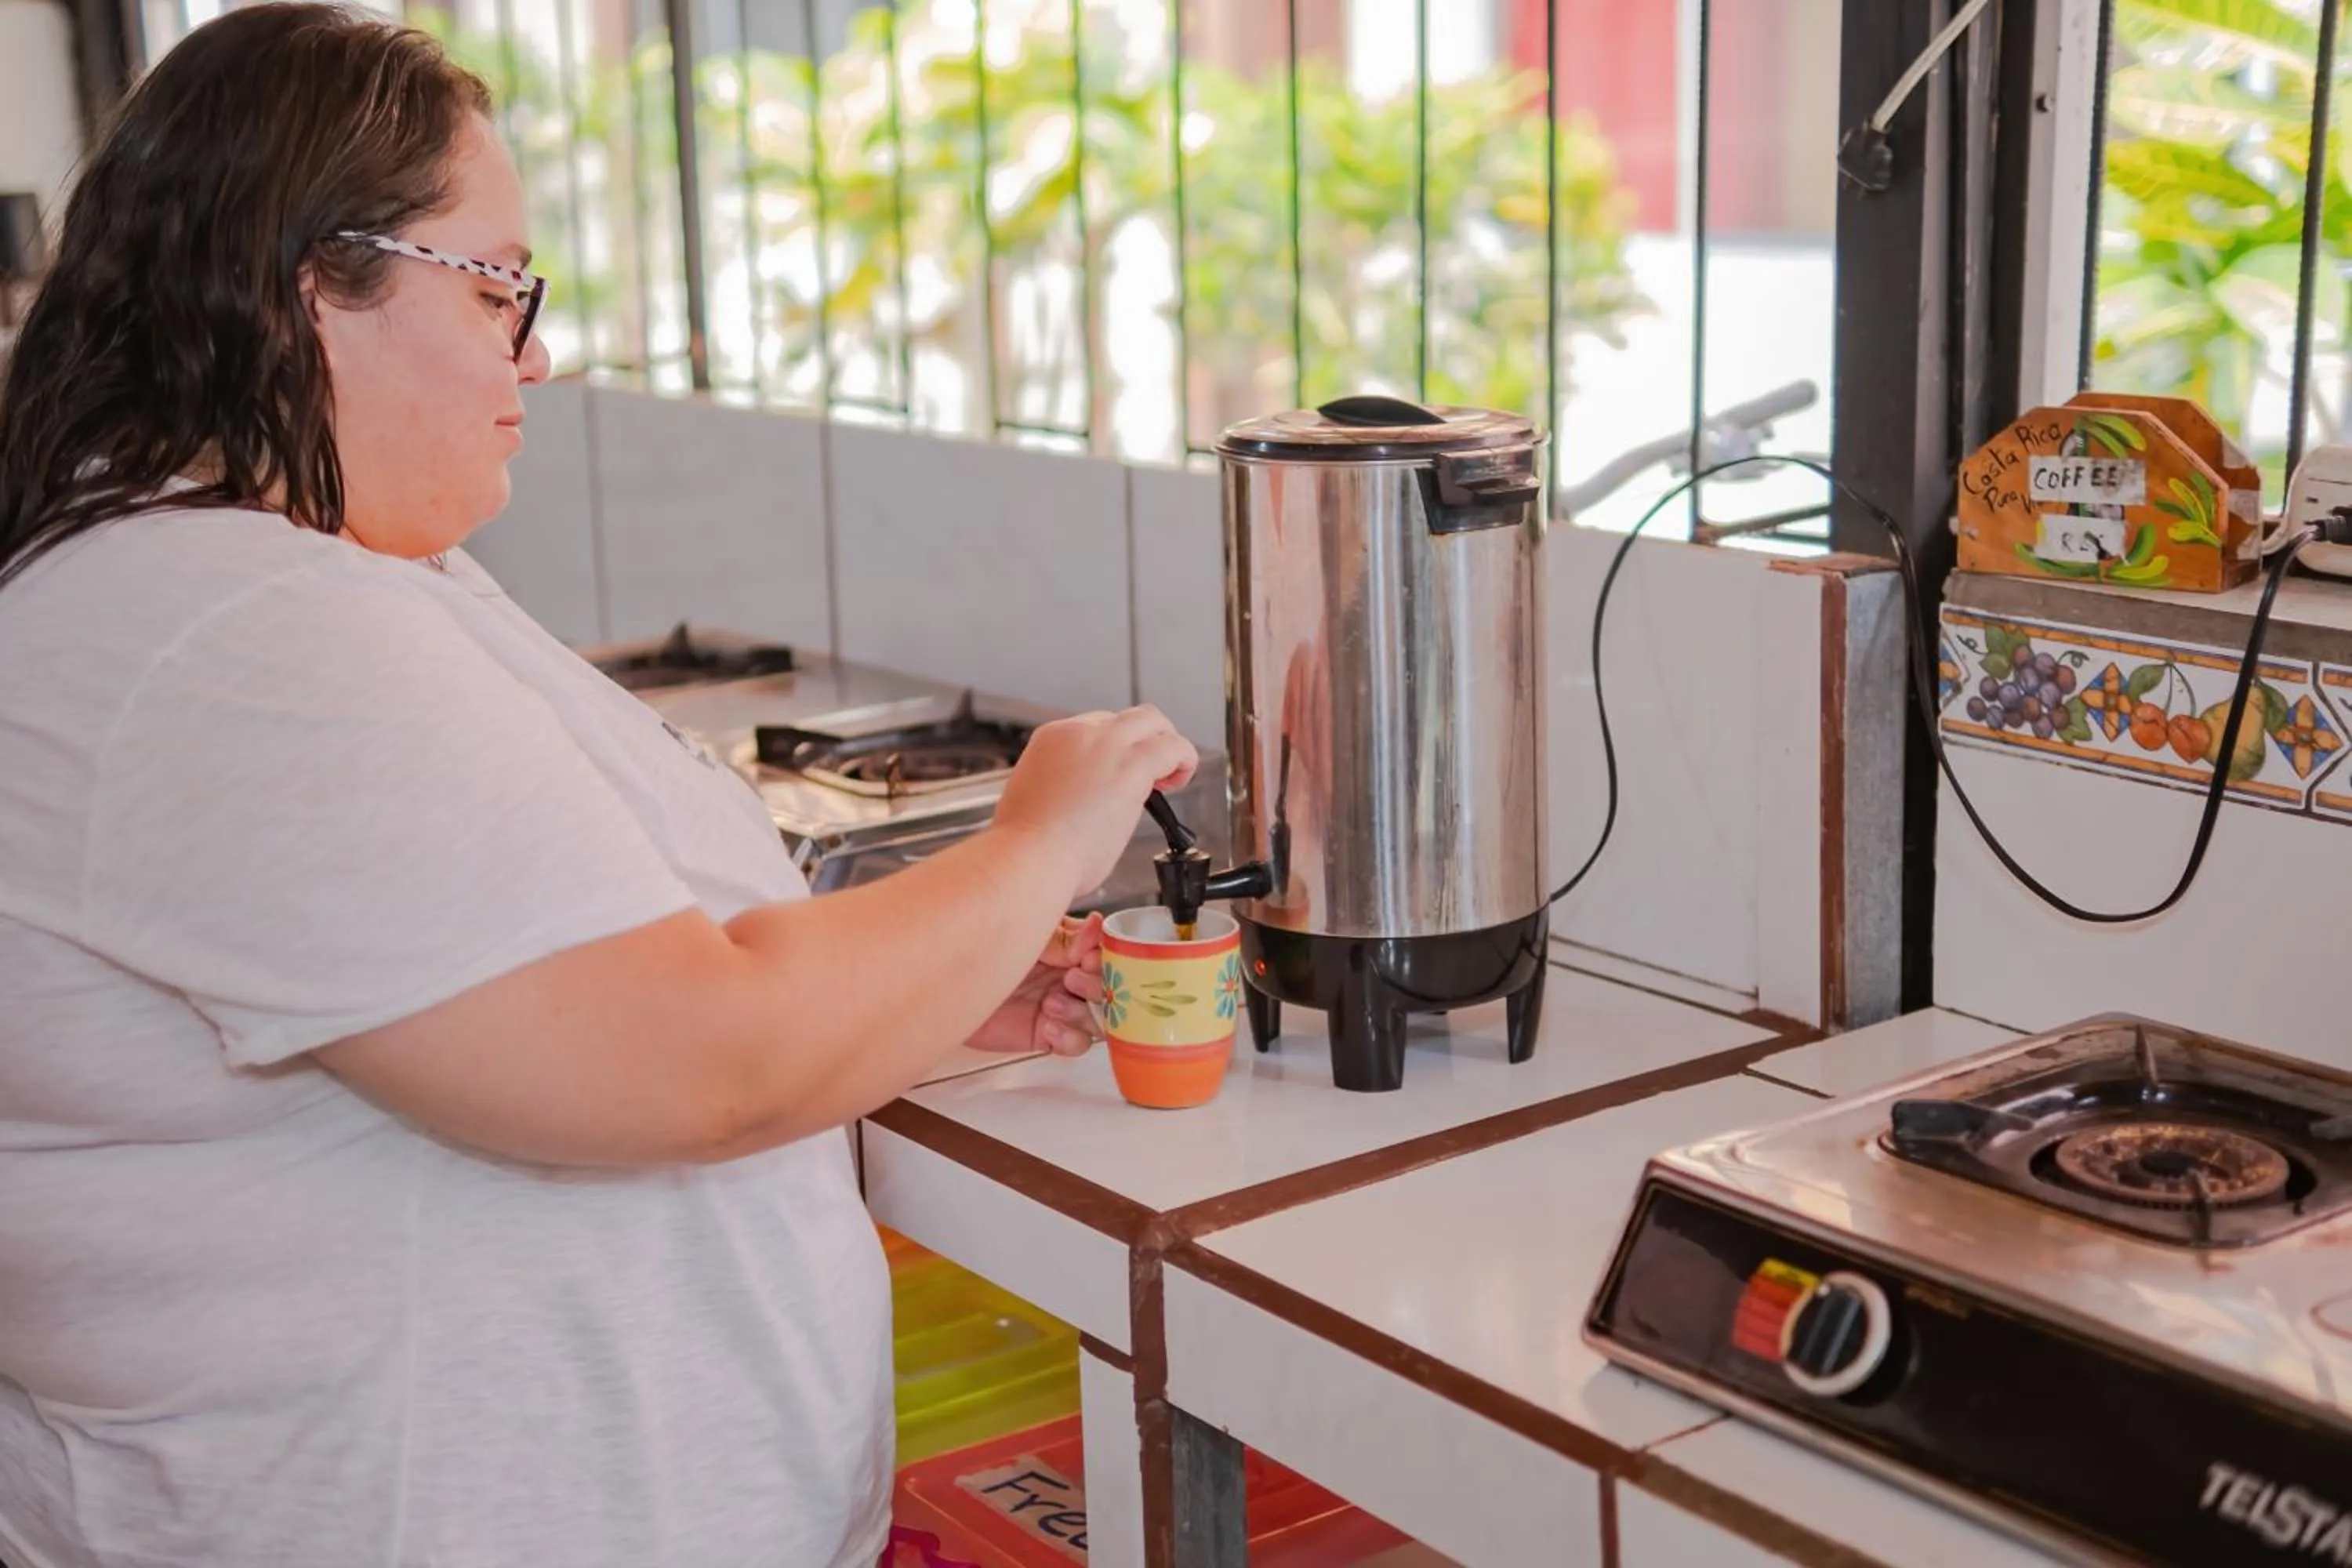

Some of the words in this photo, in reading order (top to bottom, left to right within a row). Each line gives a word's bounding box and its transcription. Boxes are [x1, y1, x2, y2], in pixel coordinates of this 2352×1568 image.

[1962, 447, 2020, 495] Costa
[2014, 423, 2062, 453] Rica
[2034, 466, 2117, 490] COFFEE
[1983, 486, 2018, 514] Pura
[2198, 1460, 2352, 1566] TELSTA
